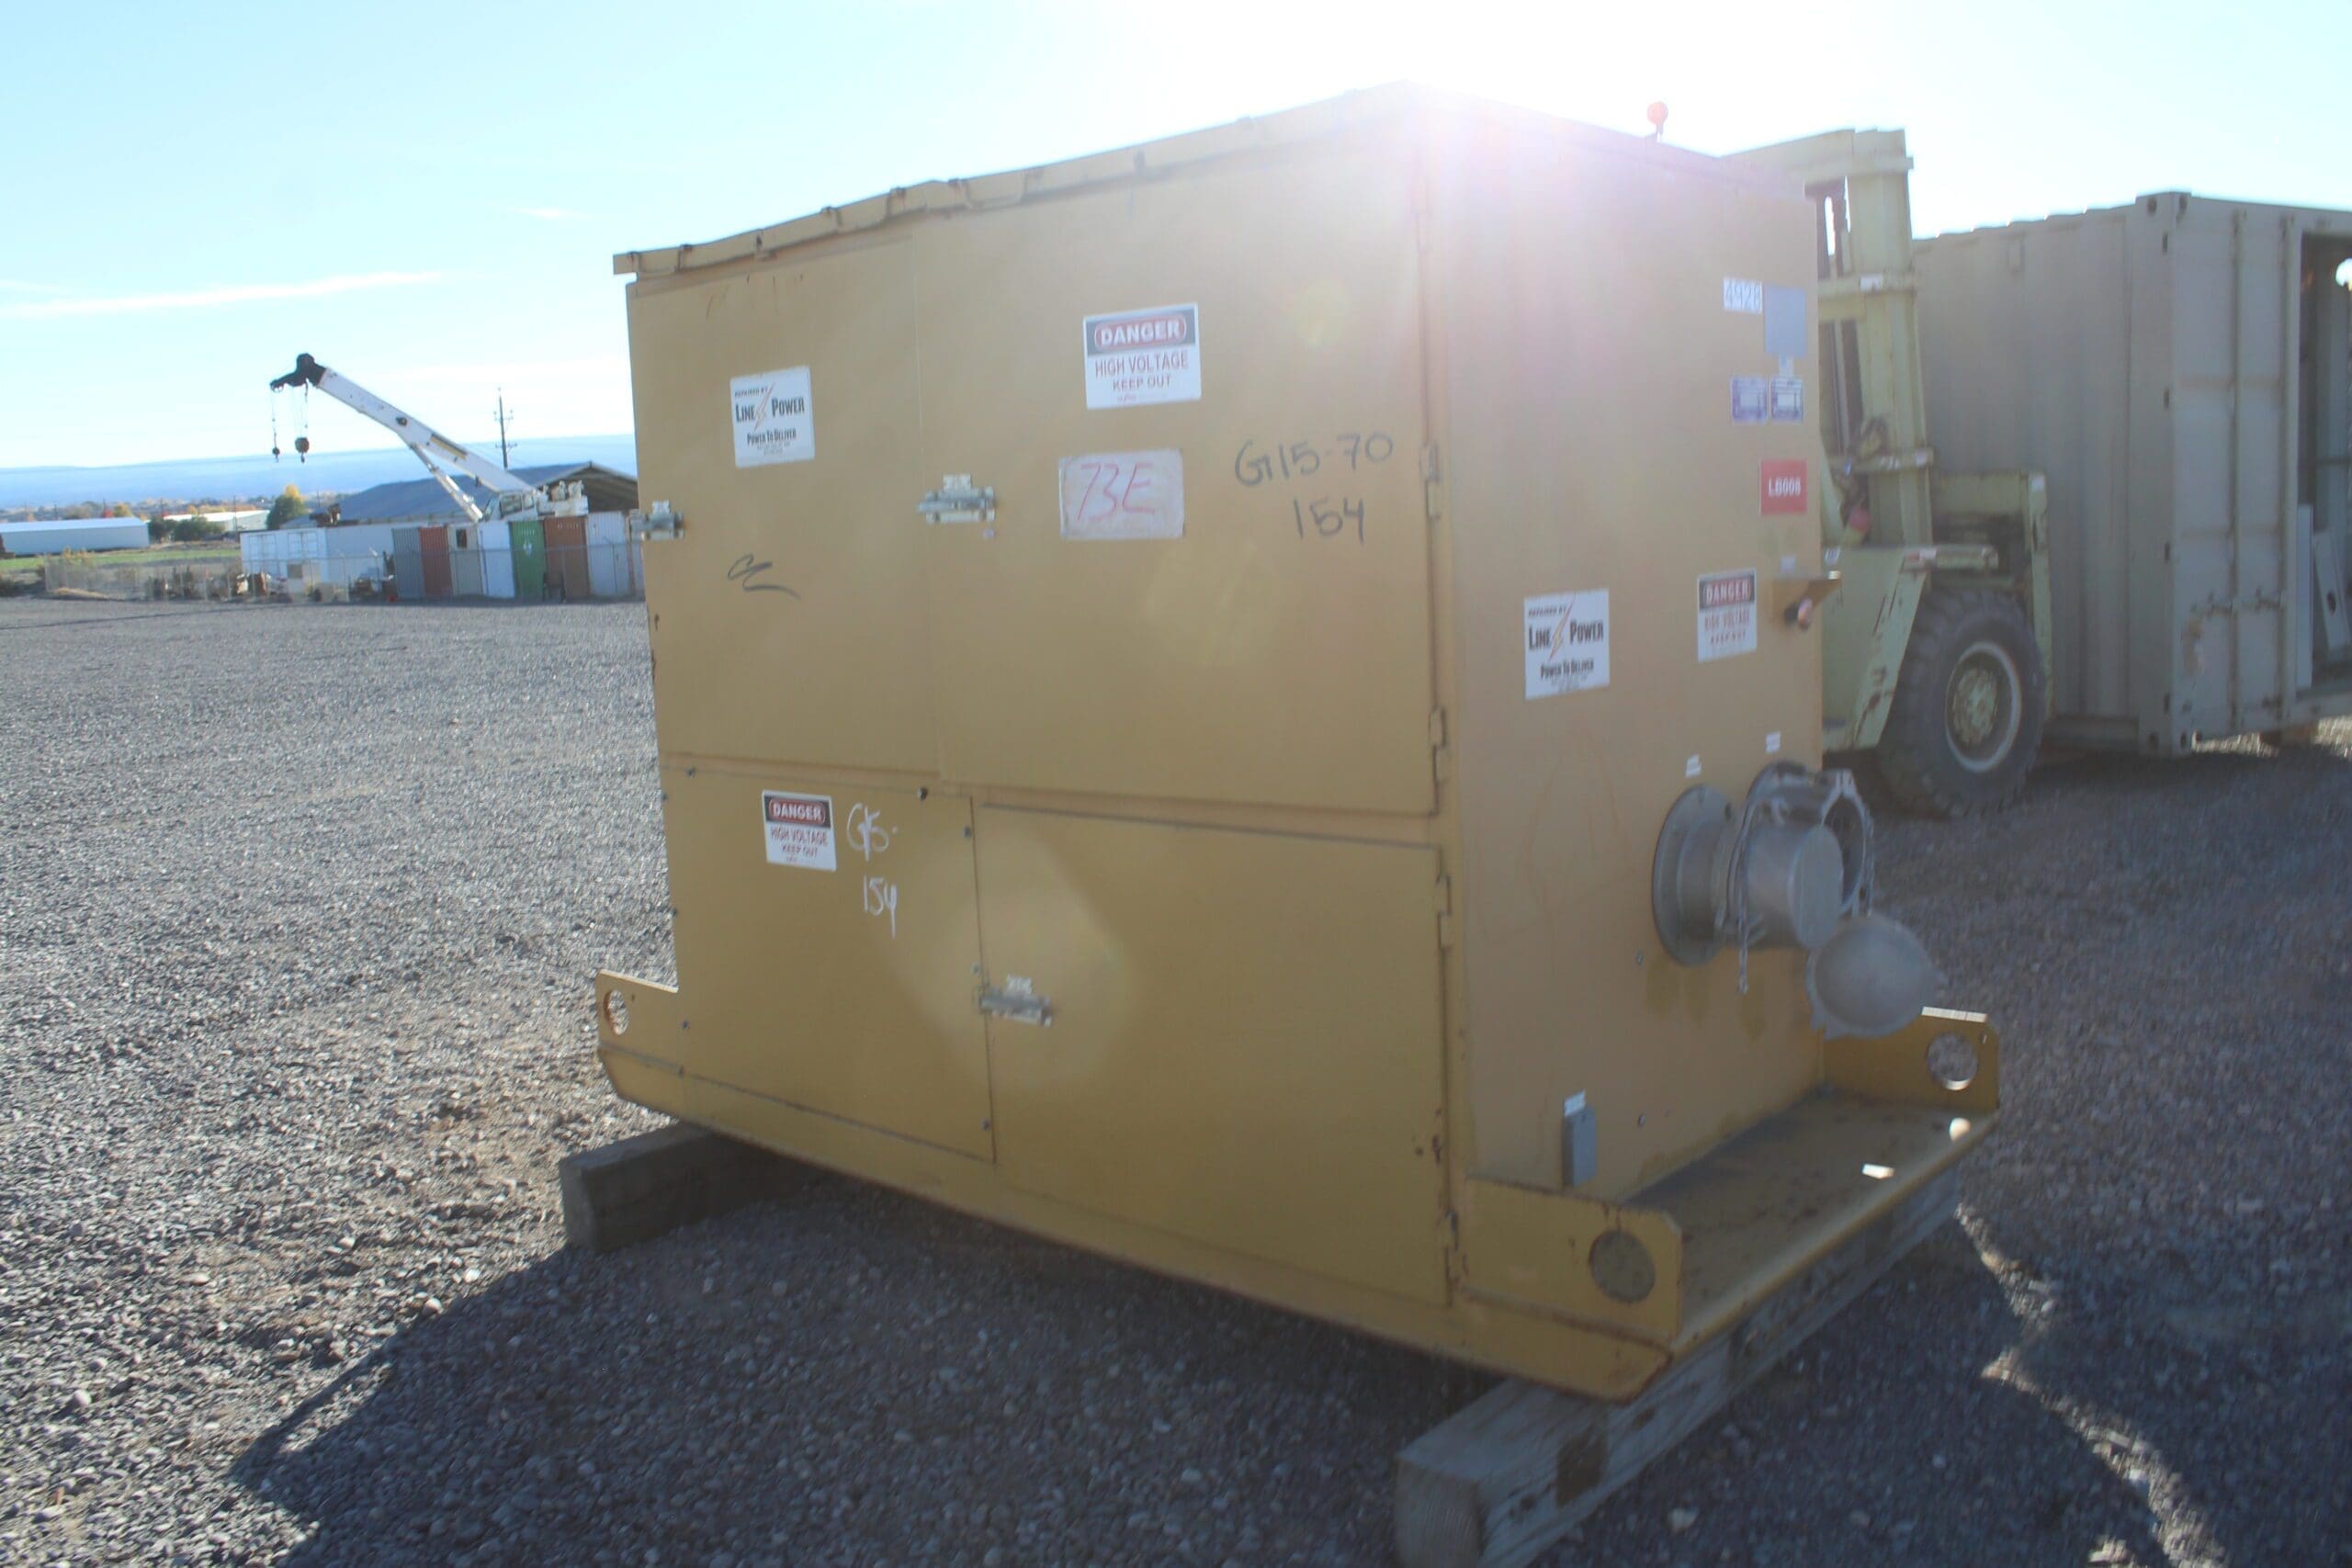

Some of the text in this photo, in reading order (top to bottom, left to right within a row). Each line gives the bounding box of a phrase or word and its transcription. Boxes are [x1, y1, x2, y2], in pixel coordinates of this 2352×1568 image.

[1101, 318, 1181, 347] DANGER
[1095, 349, 1189, 379] HIGH VOLTAGE
[1113, 373, 1171, 392] KEEP OUT
[736, 396, 805, 423] LINE POWER
[1293, 497, 1365, 545] 154
[1705, 577, 1749, 605] DANGER
[1529, 620, 1604, 651] LINE POWER
[773, 802, 822, 823] DANGER
